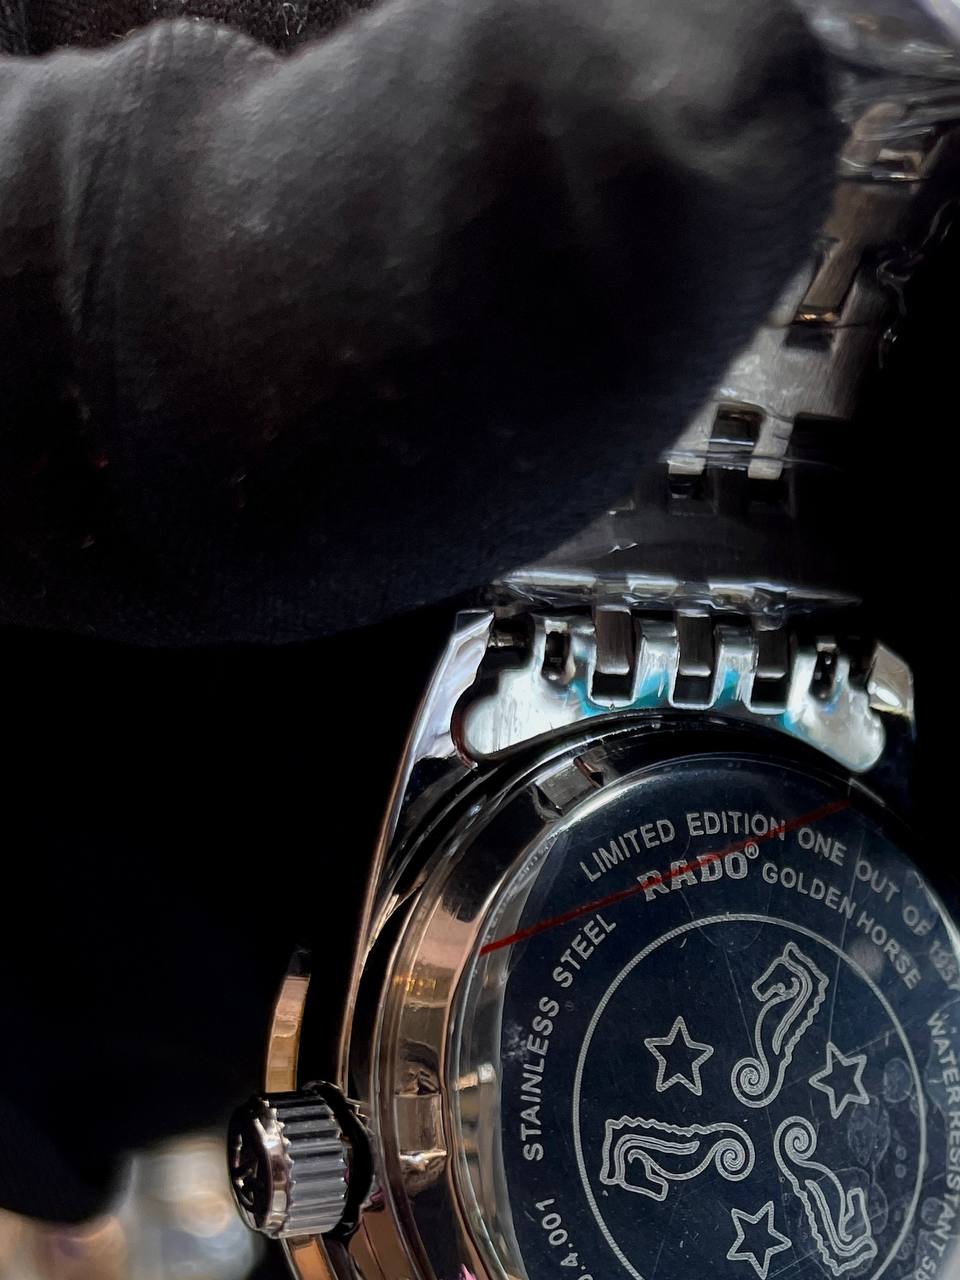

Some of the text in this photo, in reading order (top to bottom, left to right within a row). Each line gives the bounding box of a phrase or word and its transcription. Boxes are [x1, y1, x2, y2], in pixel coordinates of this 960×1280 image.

[580, 818, 676, 882] LIMITED
[688, 812, 786, 838] EDITION
[798, 827, 848, 866] ONE
[855, 859, 900, 904] OUT
[902, 905, 932, 937] OF
[763, 863, 922, 990] GOLDEN HORSE
[522, 913, 617, 1162] STAINLESS STEEL
